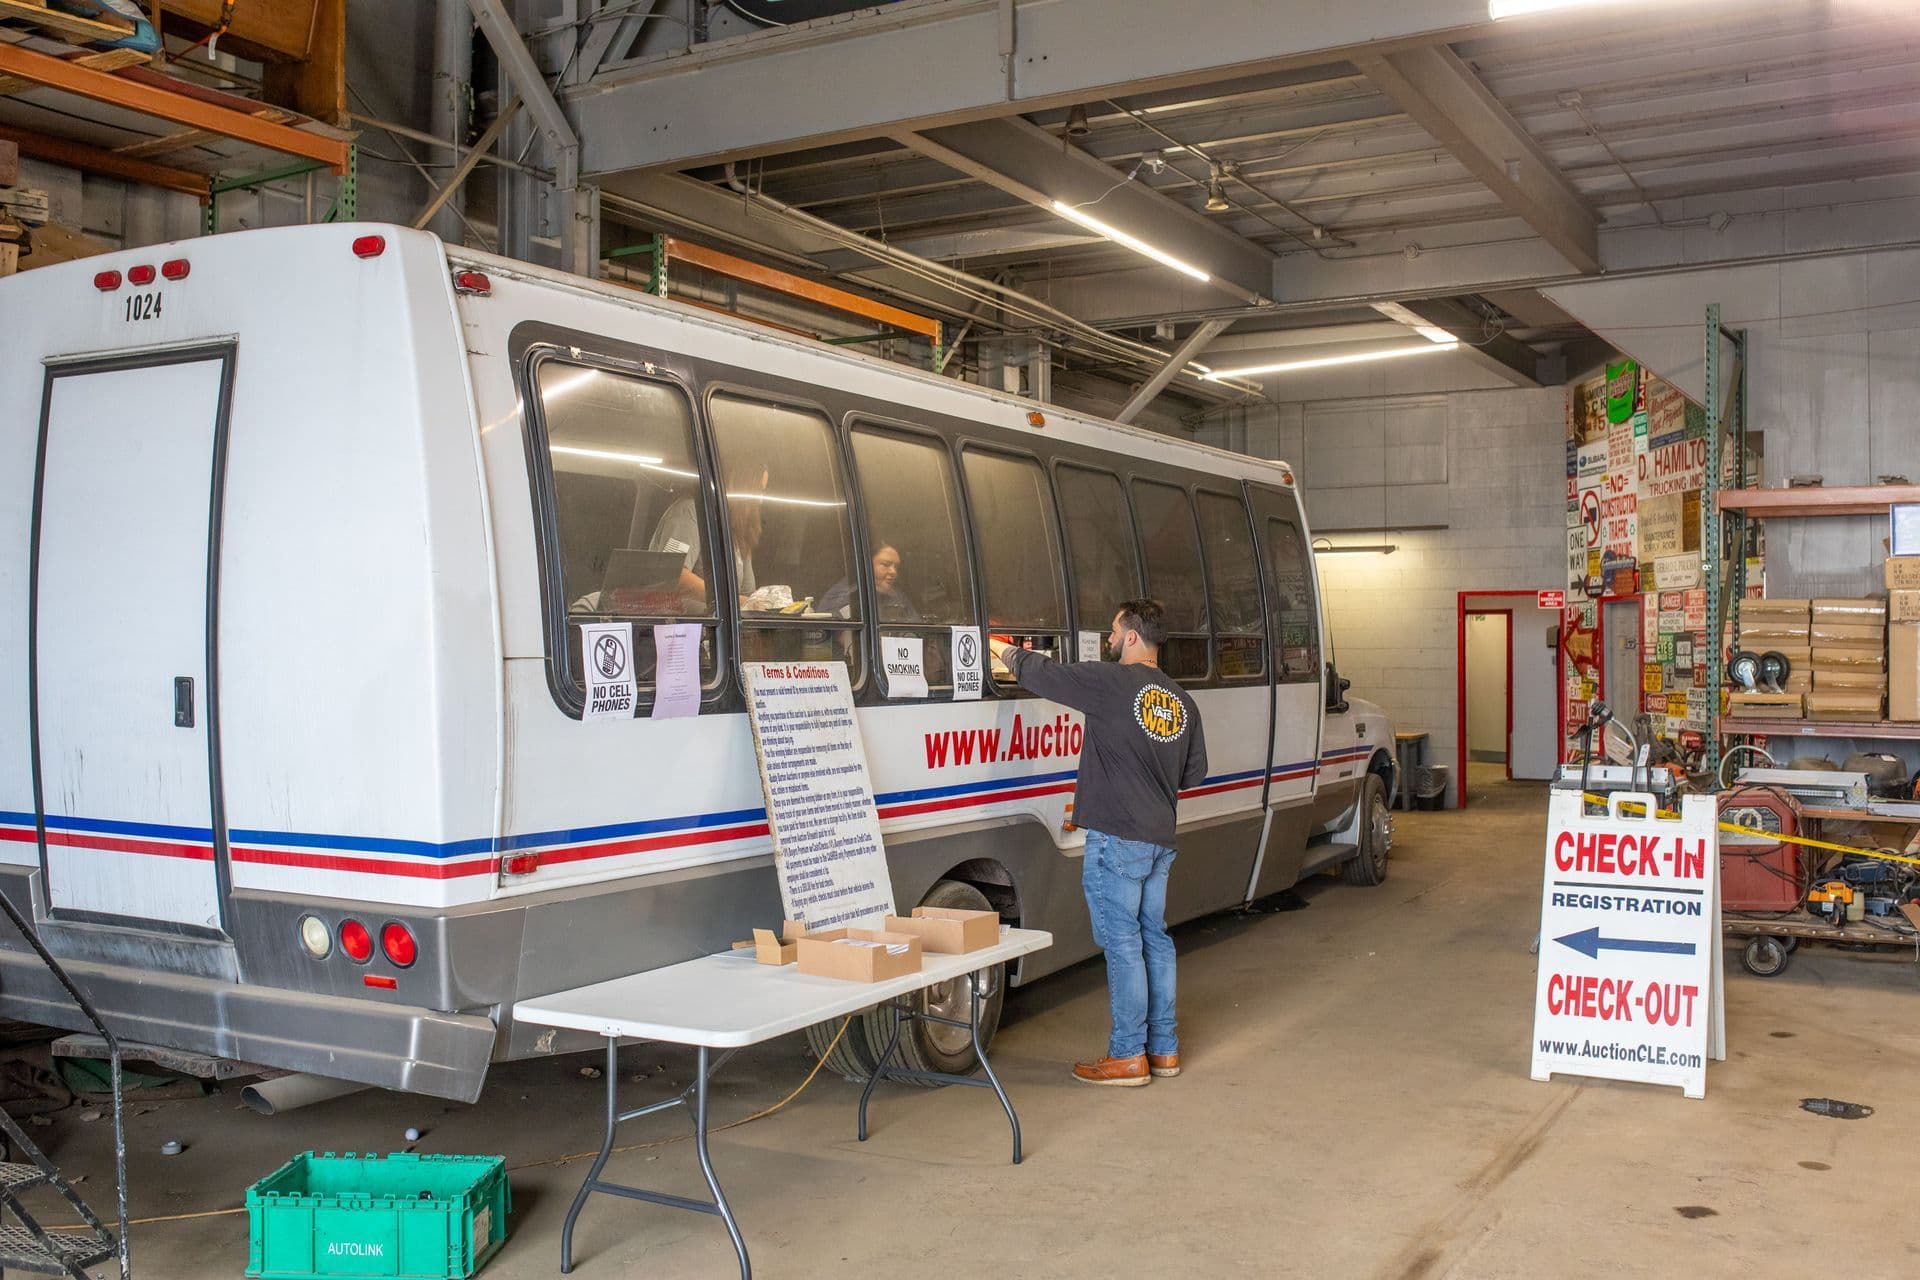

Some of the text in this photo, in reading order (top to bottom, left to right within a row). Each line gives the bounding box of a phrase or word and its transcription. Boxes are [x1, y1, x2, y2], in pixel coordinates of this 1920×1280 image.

[125, 292, 162, 321] 1024
[1638, 454, 1649, 481] D.
[1654, 438, 1706, 478] HAMILTO
[1649, 477, 1686, 496] TRUCKING
[1601, 493, 1637, 519] CONSTRUCTION
[1608, 518, 1628, 541] TRAFFIC
[1570, 531, 1584, 550] ONE
[1570, 552, 1584, 570] WAY
[1660, 595, 1680, 608] DANGER
[898, 648, 908, 658] NO
[762, 665, 830, 679] Terms & Conditions
[888, 664, 920, 674] SMOKING
[958, 671, 980, 681] NO CELL
[593, 684, 632, 699] NO CELL
[957, 681, 980, 692] PHONES
[1689, 689, 1706, 698] PRIVAT
[592, 698, 631, 712] PHONES
[1161, 694, 1181, 717] THE
[1570, 703, 1586, 720] EXIT
[1648, 696, 1666, 709] DANGER
[926, 713, 1082, 769] www.Auctio
[1554, 830, 1704, 880] CHECK-IN
[1552, 892, 1702, 916] REGISTRATION
[1547, 973, 1698, 1027] CHECK-OUT
[1539, 1039, 1702, 1068] www.AuctionCLE.com
[328, 1242, 384, 1256] AUTOLINK
